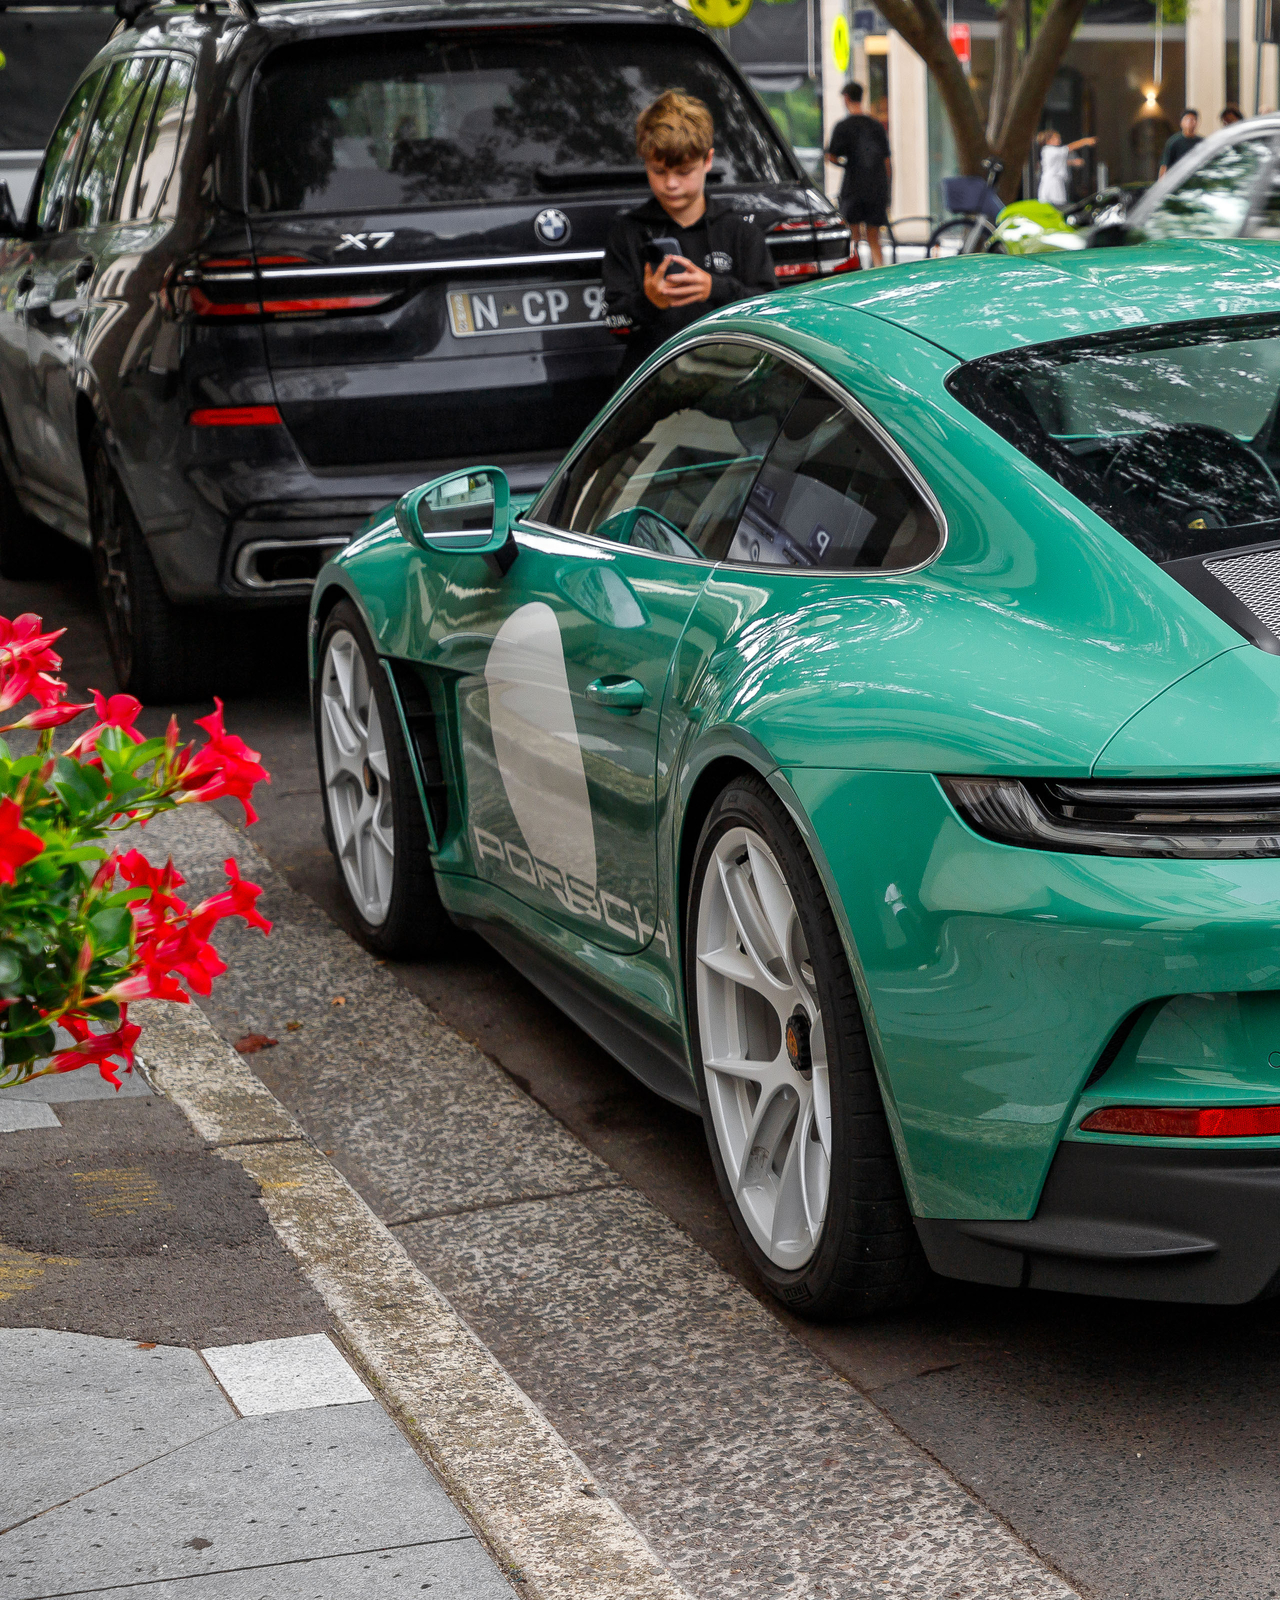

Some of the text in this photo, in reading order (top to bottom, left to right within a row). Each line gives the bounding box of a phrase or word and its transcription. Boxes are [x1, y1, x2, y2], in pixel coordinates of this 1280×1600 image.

[334, 231, 395, 251] X7
[472, 294, 499, 330] N
[522, 289, 569, 325] CP
[474, 827, 671, 958] PORSCH
